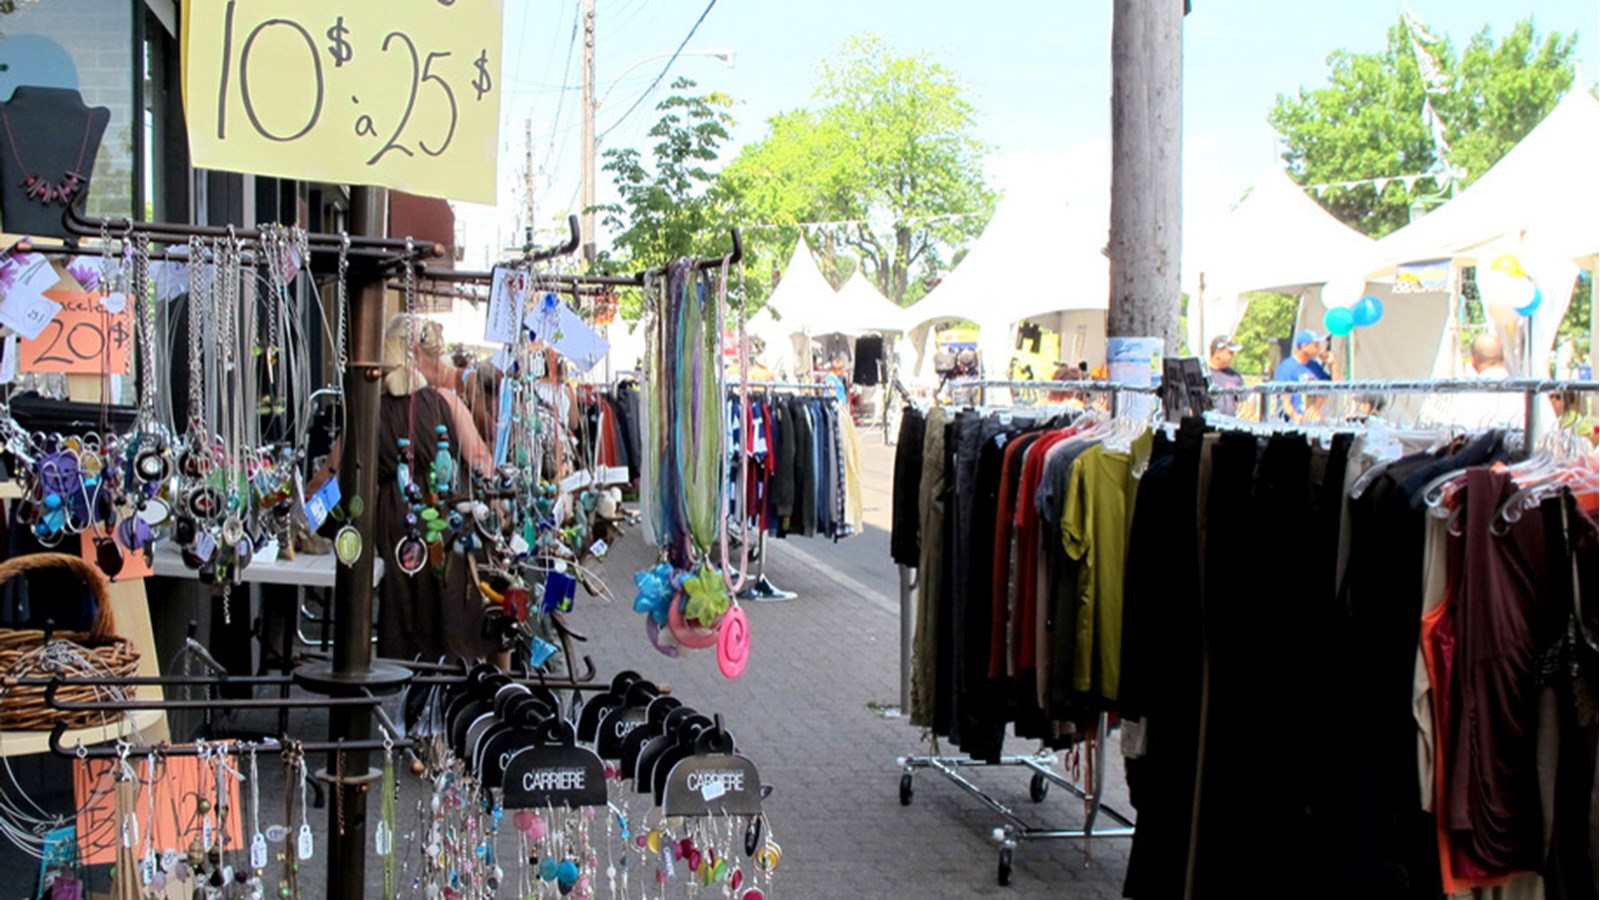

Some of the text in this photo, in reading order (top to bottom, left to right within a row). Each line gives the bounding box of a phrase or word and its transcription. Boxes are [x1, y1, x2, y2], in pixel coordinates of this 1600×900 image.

[217, 0, 492, 166] 10$ à 25$
[522, 771, 586, 792] CARRIERE
